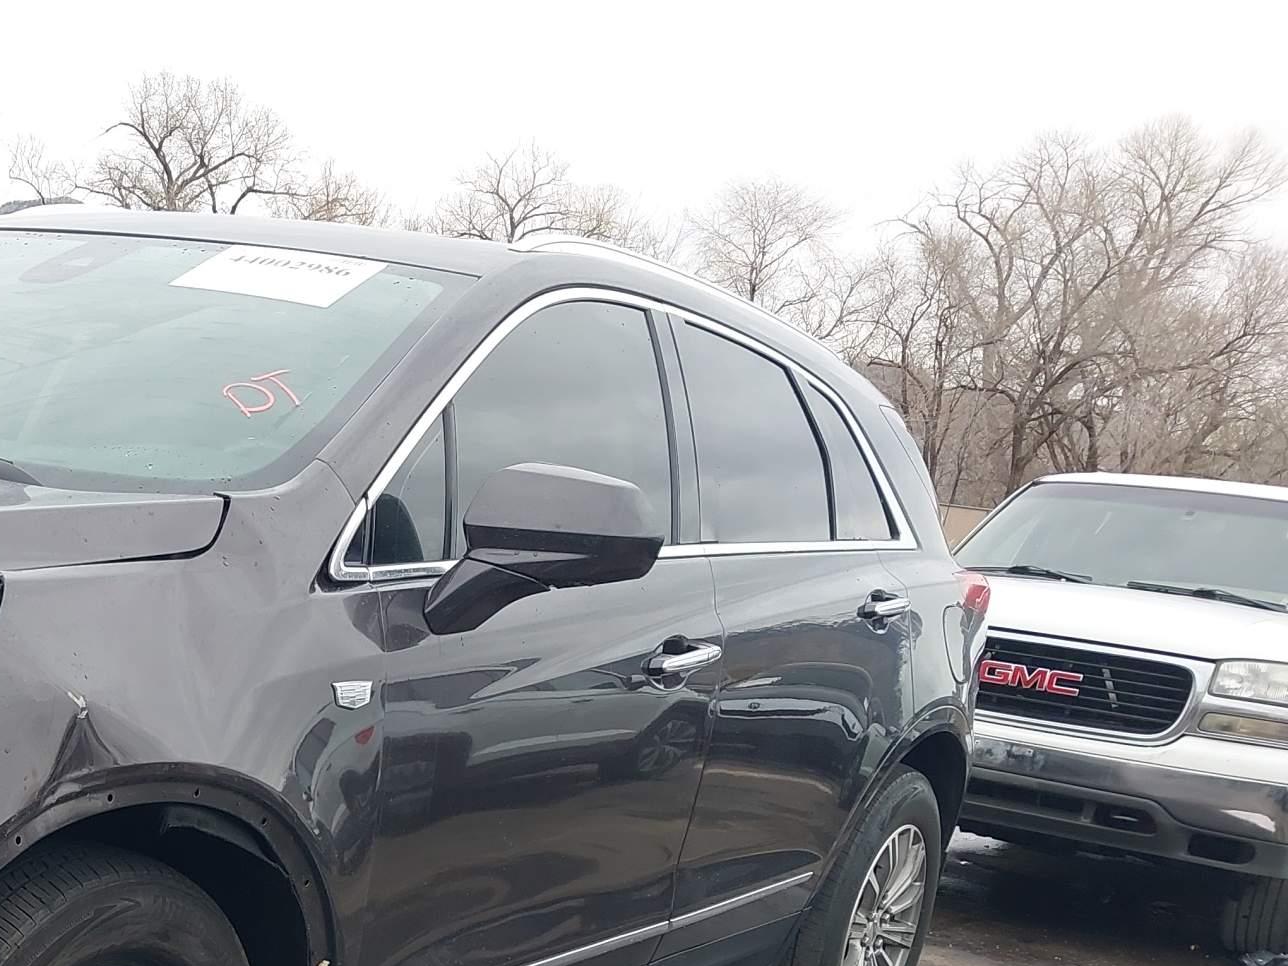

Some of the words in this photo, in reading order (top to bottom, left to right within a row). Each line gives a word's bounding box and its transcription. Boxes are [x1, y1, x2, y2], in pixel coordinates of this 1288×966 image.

[228, 254, 352, 278] 44002986
[223, 369, 302, 417] DT
[978, 659, 1084, 697] GMC
